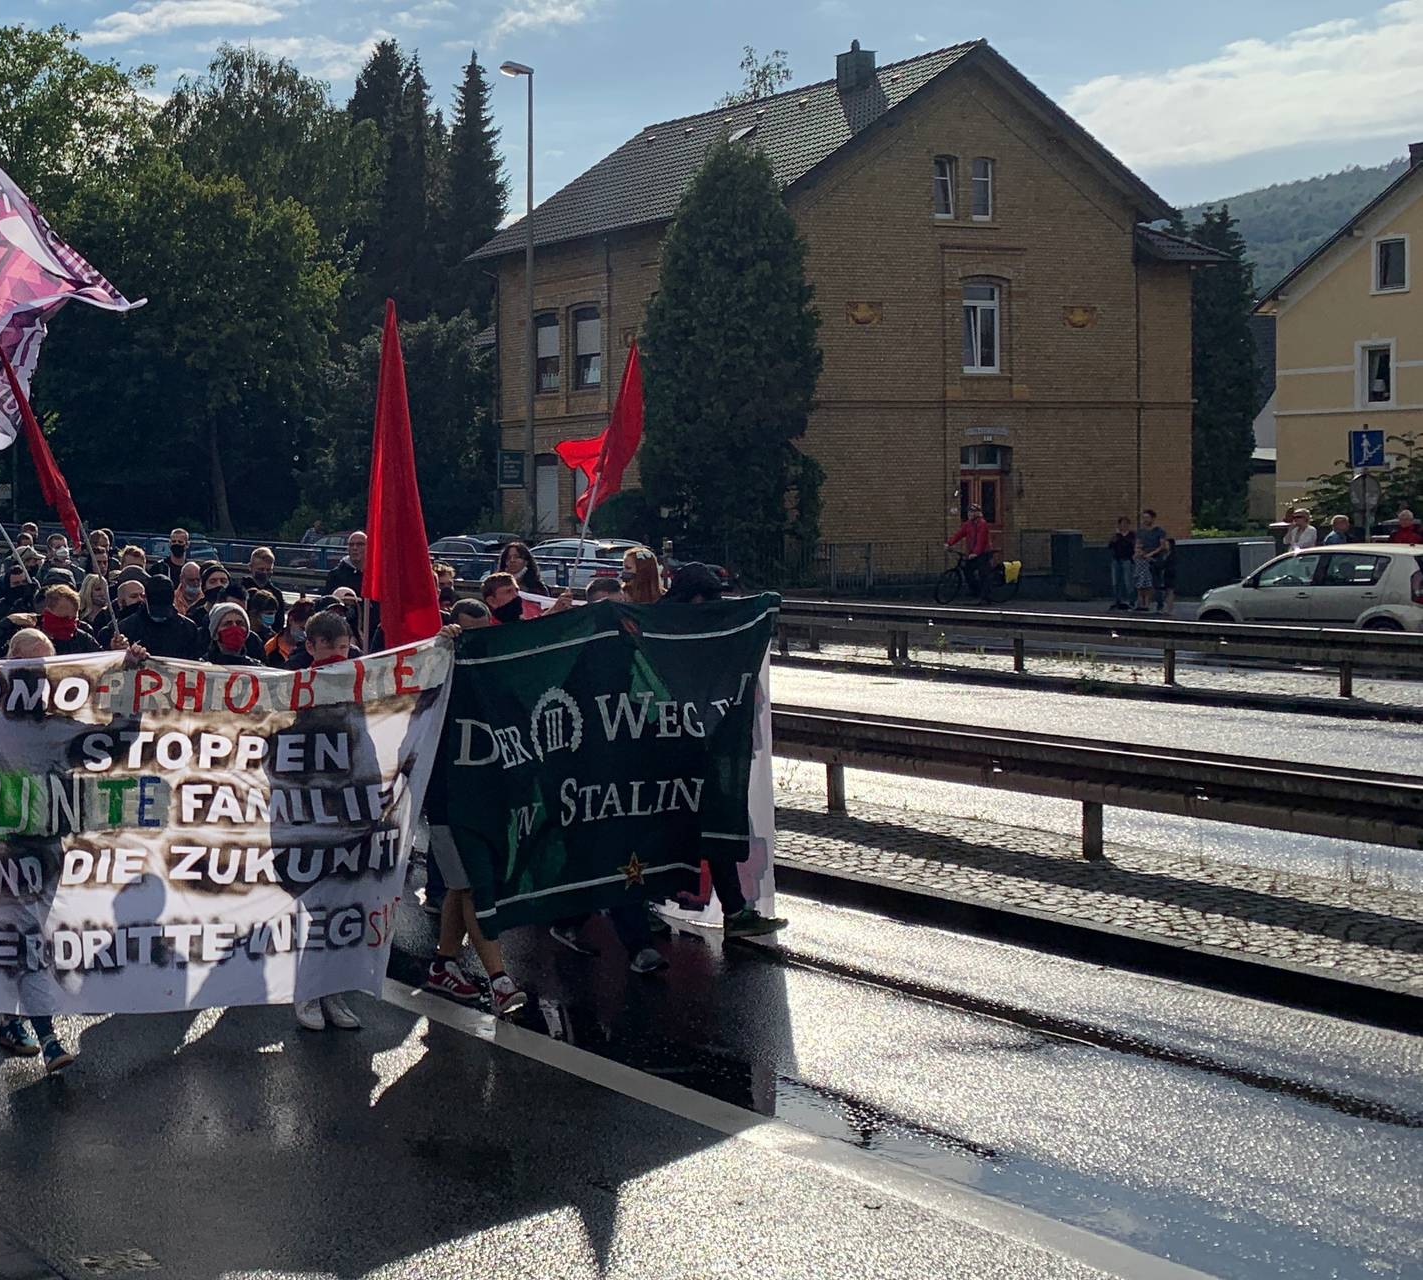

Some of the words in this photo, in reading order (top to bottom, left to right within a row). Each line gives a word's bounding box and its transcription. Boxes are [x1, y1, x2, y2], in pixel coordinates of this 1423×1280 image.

[595, 691, 705, 742] WEG
[82, 733, 349, 772] STOPPEN
[61, 848, 147, 886] DIE
[169, 828, 400, 885] ZUKUNFT
